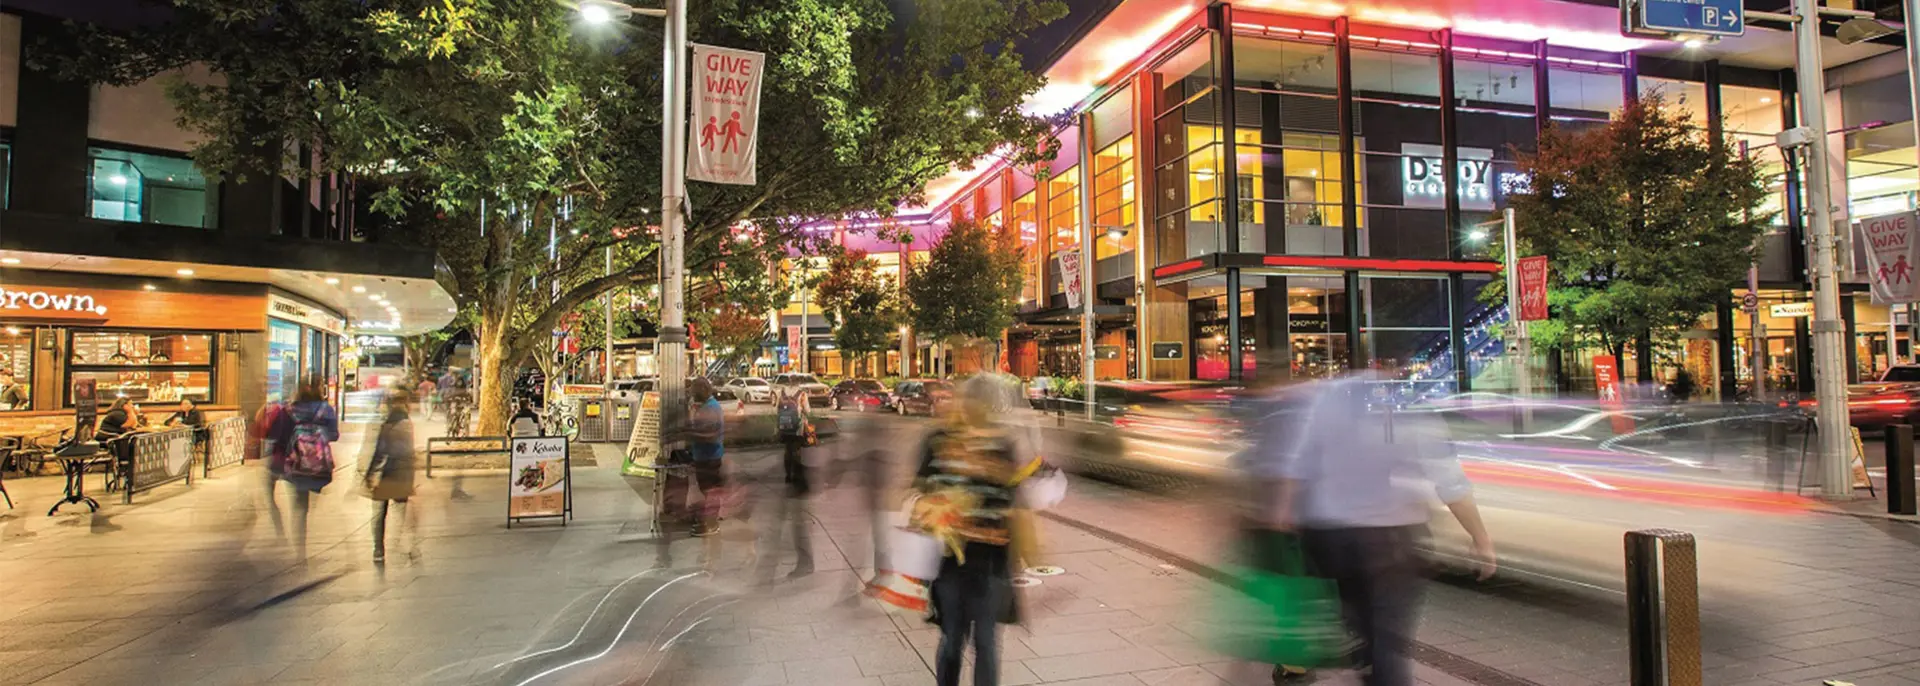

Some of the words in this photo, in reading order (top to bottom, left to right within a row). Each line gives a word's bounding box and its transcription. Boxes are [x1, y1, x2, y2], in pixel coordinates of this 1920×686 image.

[1706, 9, 1715, 23] P
[707, 53, 751, 76] GIVE
[706, 75, 748, 97] WAY
[1409, 156, 1490, 184] DEDY
[1870, 217, 1907, 234] GIVE
[1872, 231, 1907, 248] WAY
[1523, 260, 1542, 270] GIVE
[1524, 270, 1541, 281] WAY
[0, 287, 107, 316] rown.
